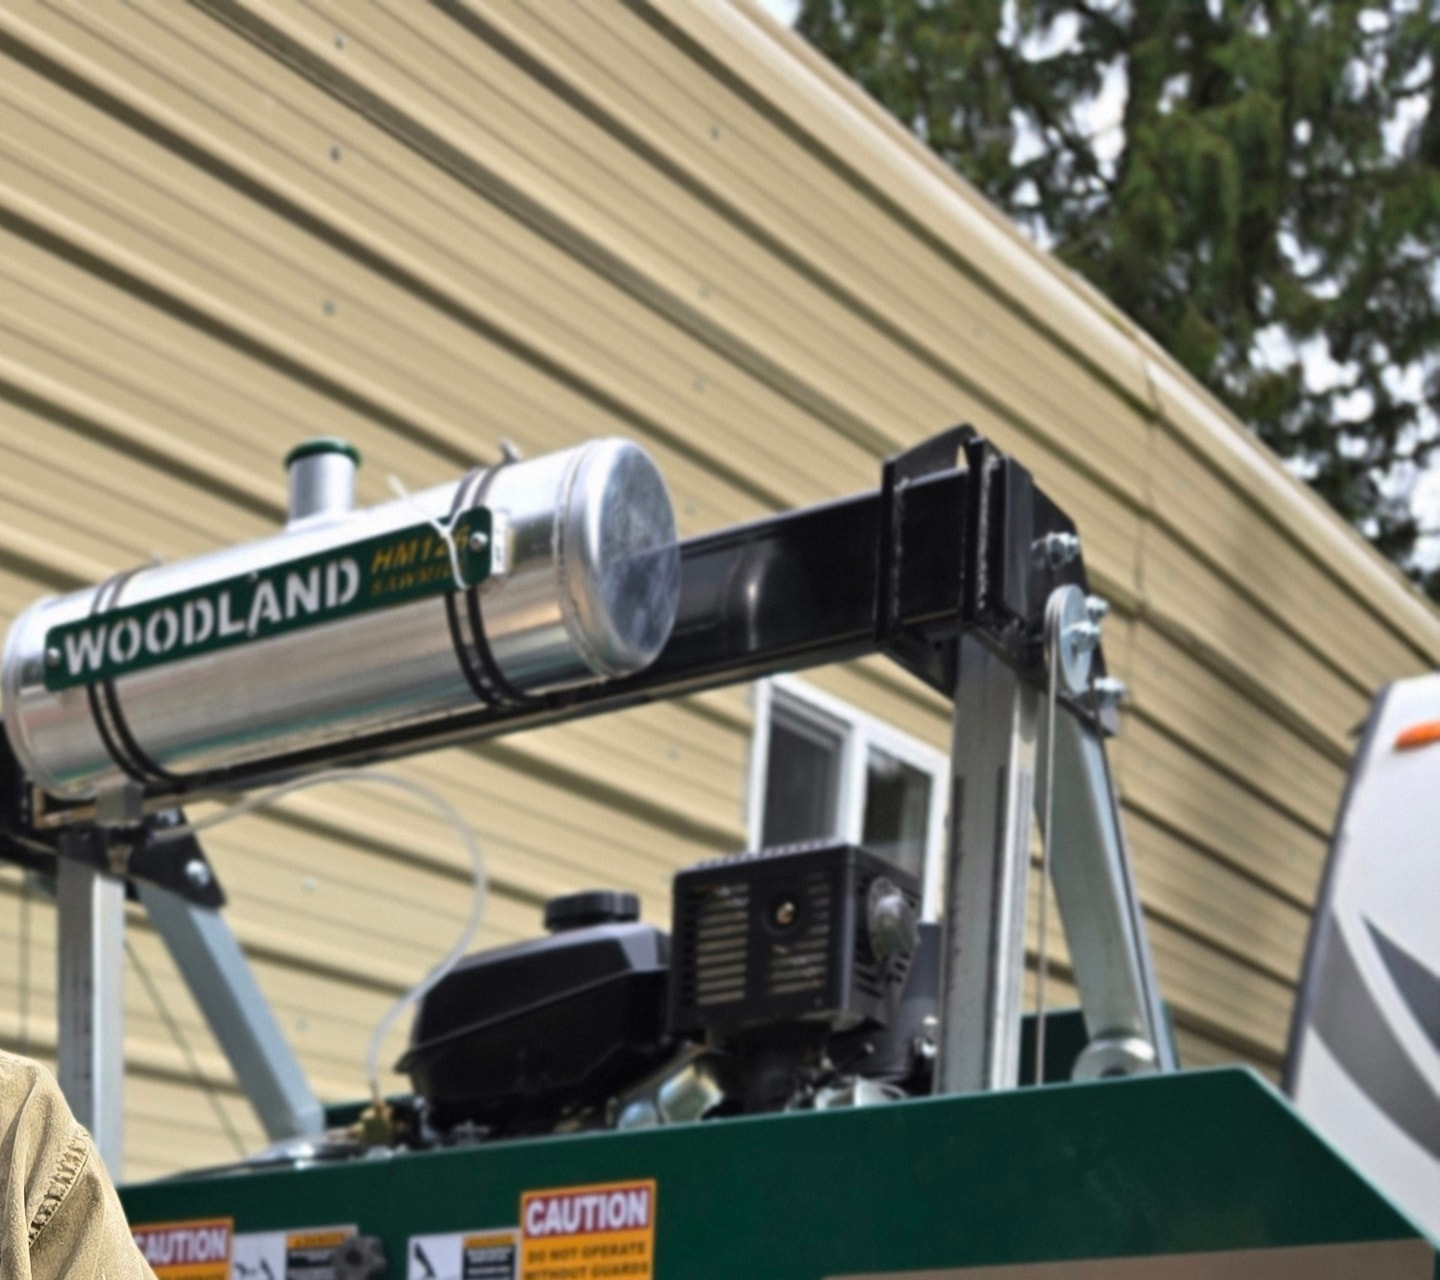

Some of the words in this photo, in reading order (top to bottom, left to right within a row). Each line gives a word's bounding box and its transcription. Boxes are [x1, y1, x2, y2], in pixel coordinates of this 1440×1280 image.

[61, 556, 360, 676] WOODLAND
[526, 1189, 648, 1236] CAUTION
[581, 1241, 645, 1259] OPERATE
